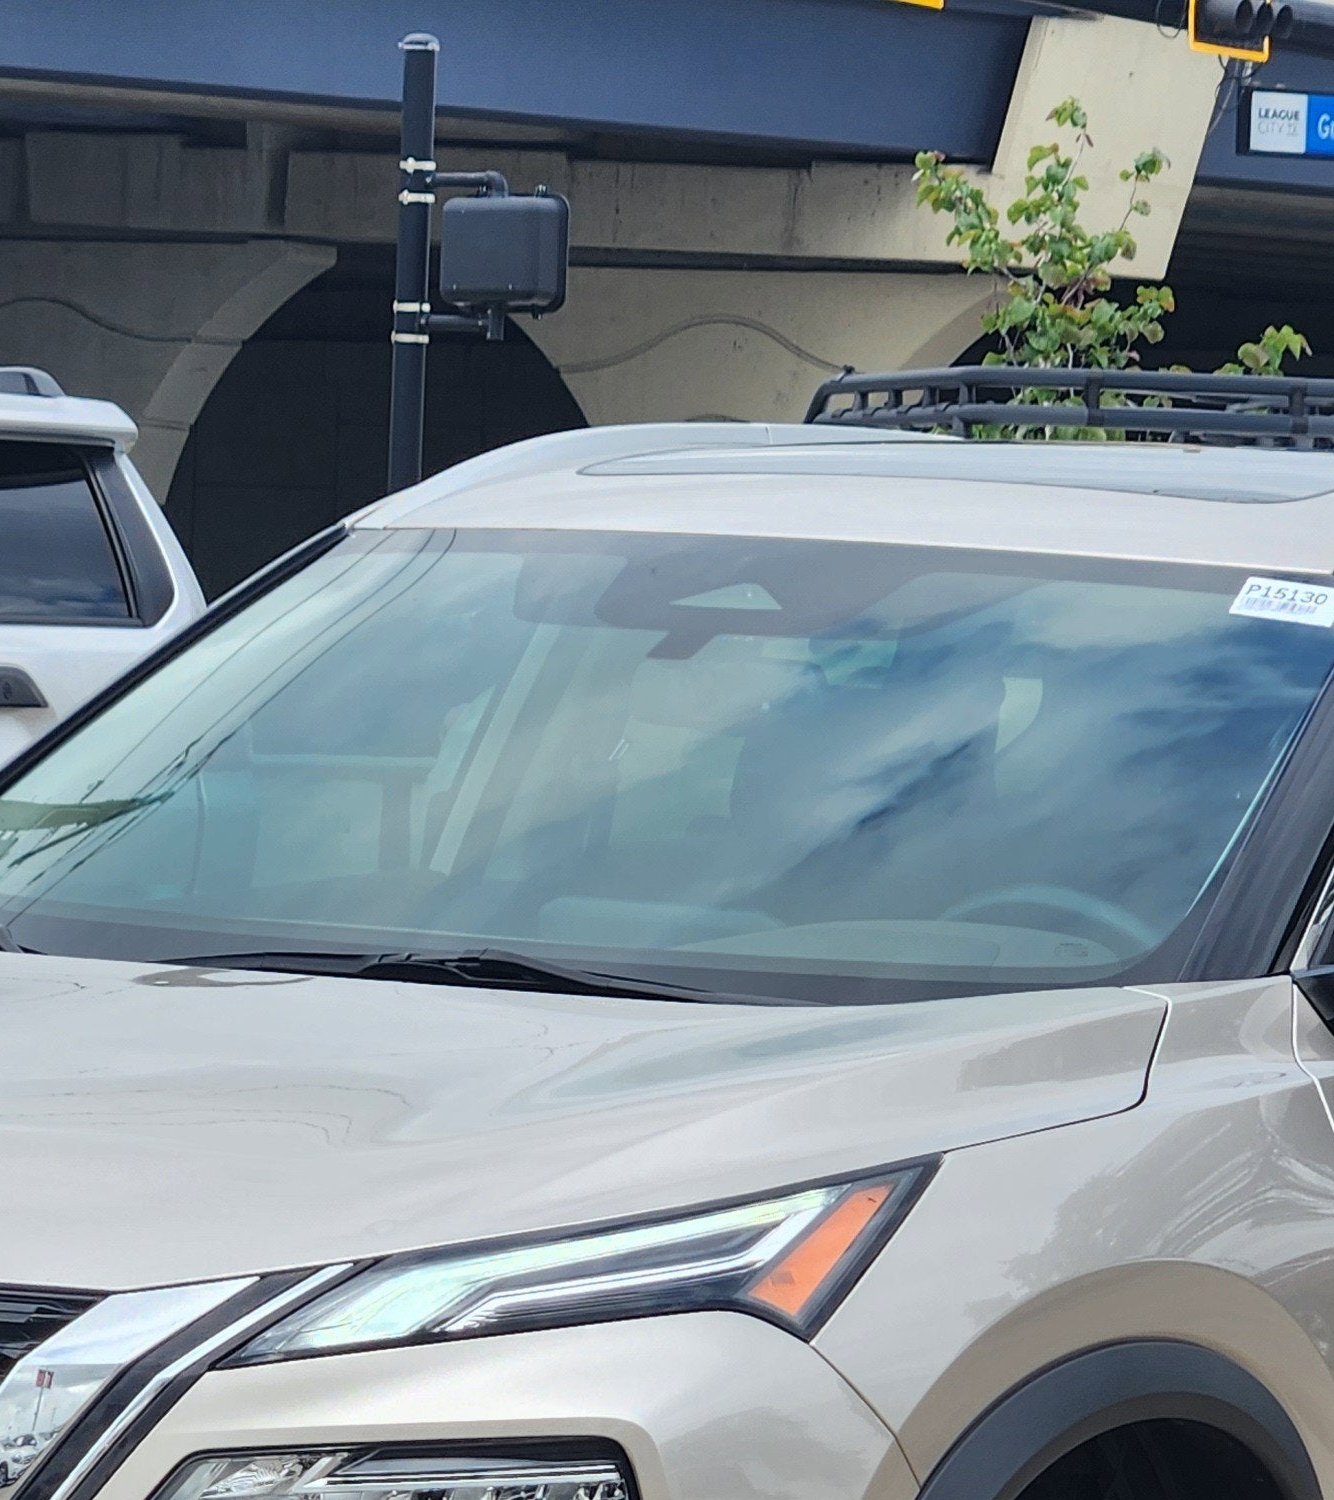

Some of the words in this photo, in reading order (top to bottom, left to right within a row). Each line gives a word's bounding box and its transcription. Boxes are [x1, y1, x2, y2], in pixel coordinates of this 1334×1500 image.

[1258, 107, 1300, 120] LEAGUE
[1257, 121, 1285, 135] CITY
[1245, 583, 1329, 606] P15130
